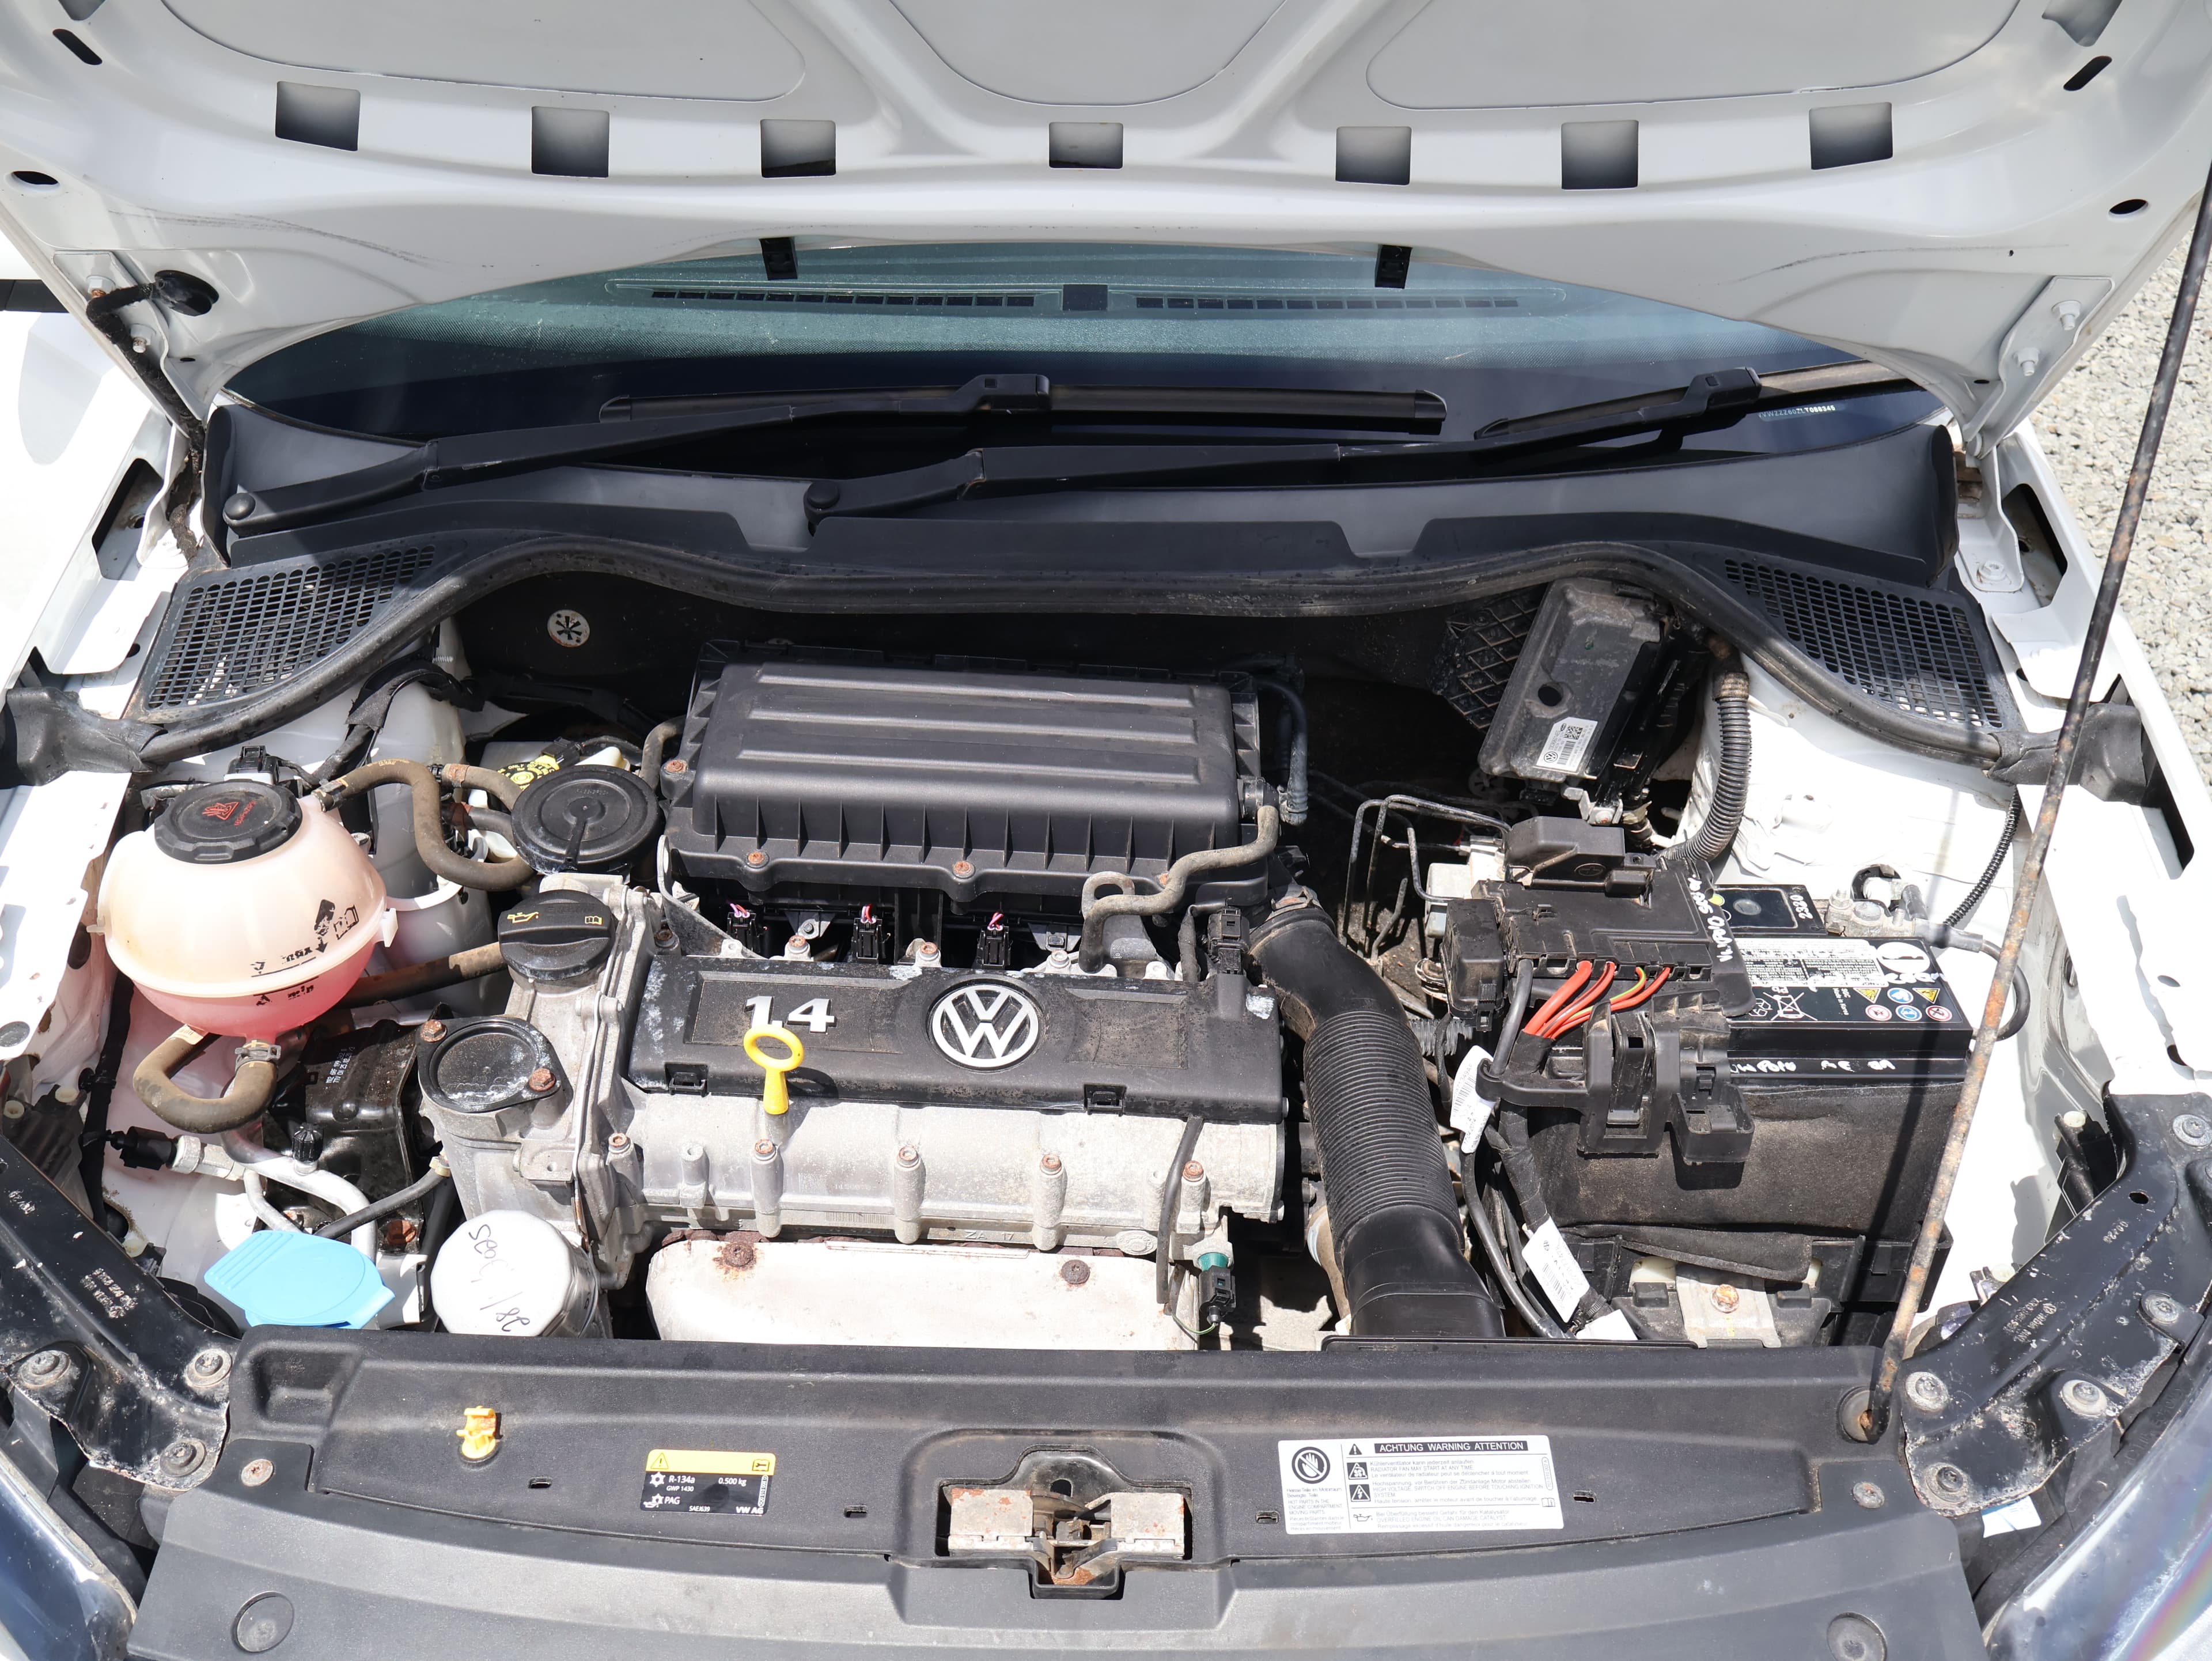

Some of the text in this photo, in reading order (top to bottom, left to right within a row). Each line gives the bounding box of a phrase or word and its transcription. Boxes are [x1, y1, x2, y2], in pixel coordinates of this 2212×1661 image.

[1790, 894, 1813, 920] 2320
[1380, 1441, 1524, 1452] ACHTUNG WARNING ATTENTION
[668, 1475, 747, 1487] R-134a 0.500 kg
[664, 1496, 681, 1505] PAG
